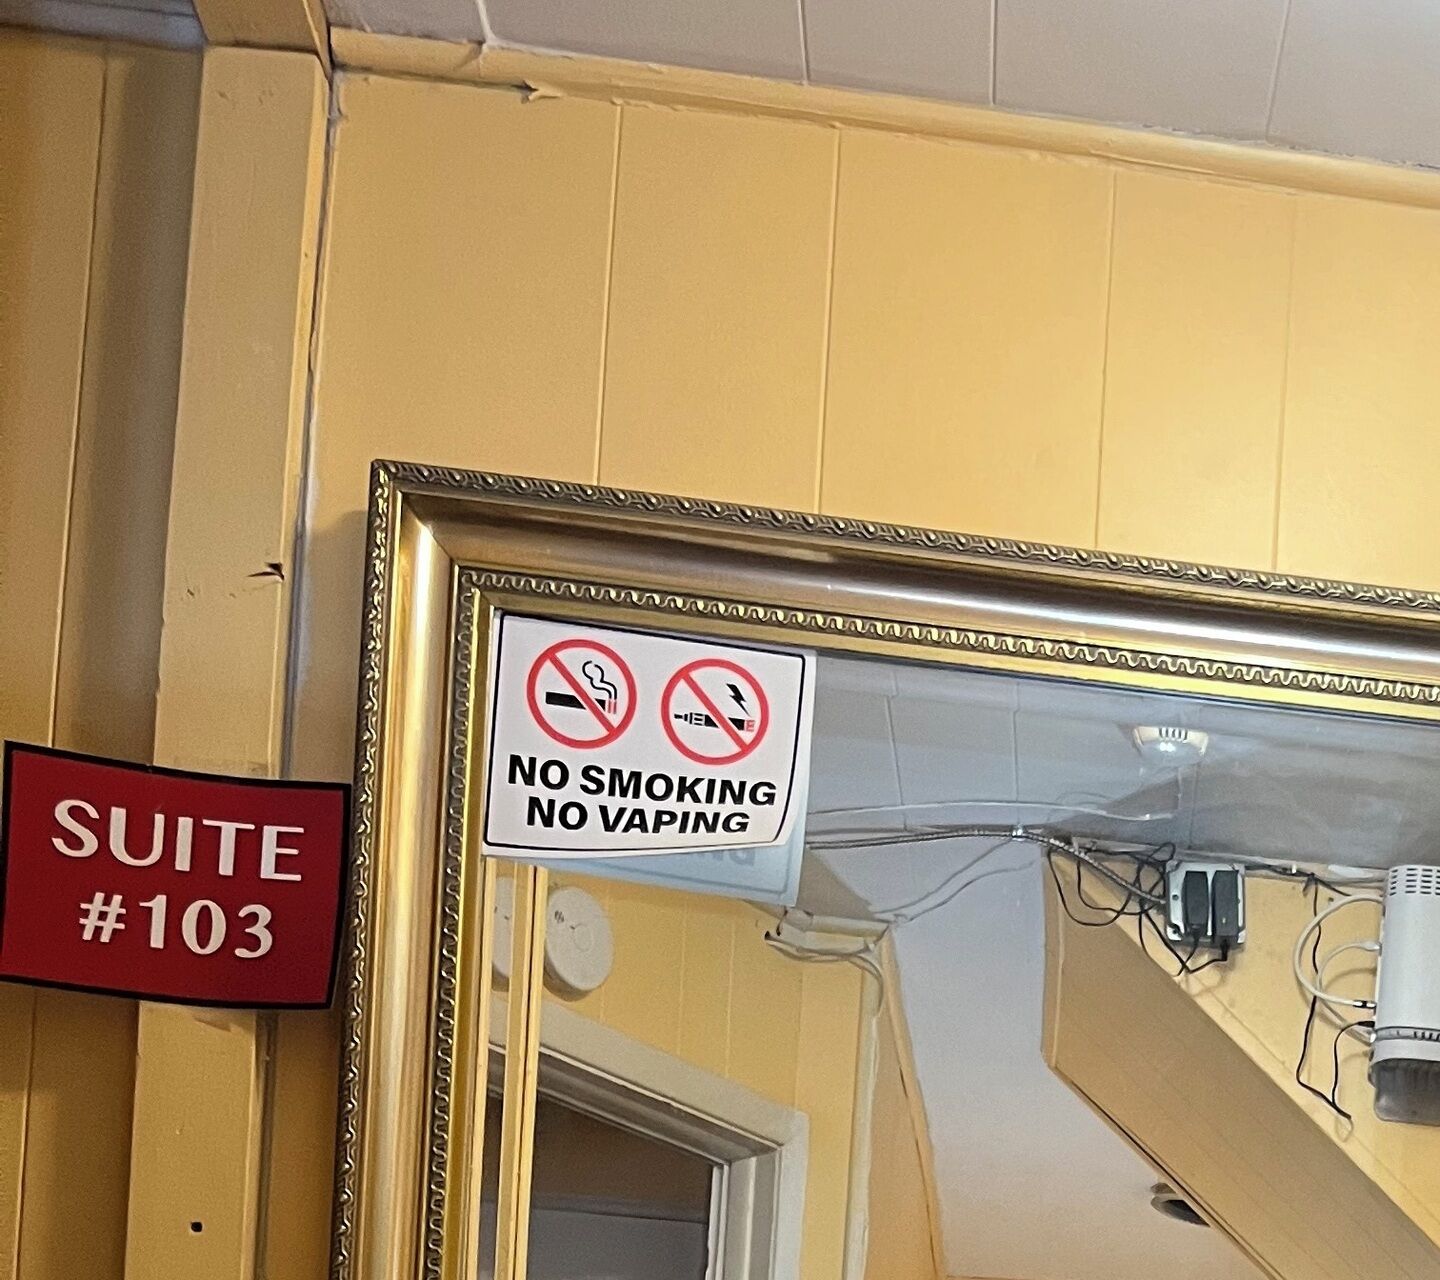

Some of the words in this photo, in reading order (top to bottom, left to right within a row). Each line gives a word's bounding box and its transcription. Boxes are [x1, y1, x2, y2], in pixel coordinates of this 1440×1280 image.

[507, 753, 570, 791] NO
[579, 764, 777, 807] SMOKING
[51, 798, 305, 882] SUITE
[526, 795, 589, 831] NO
[598, 804, 751, 835] VAPING
[78, 891, 274, 959] #103
